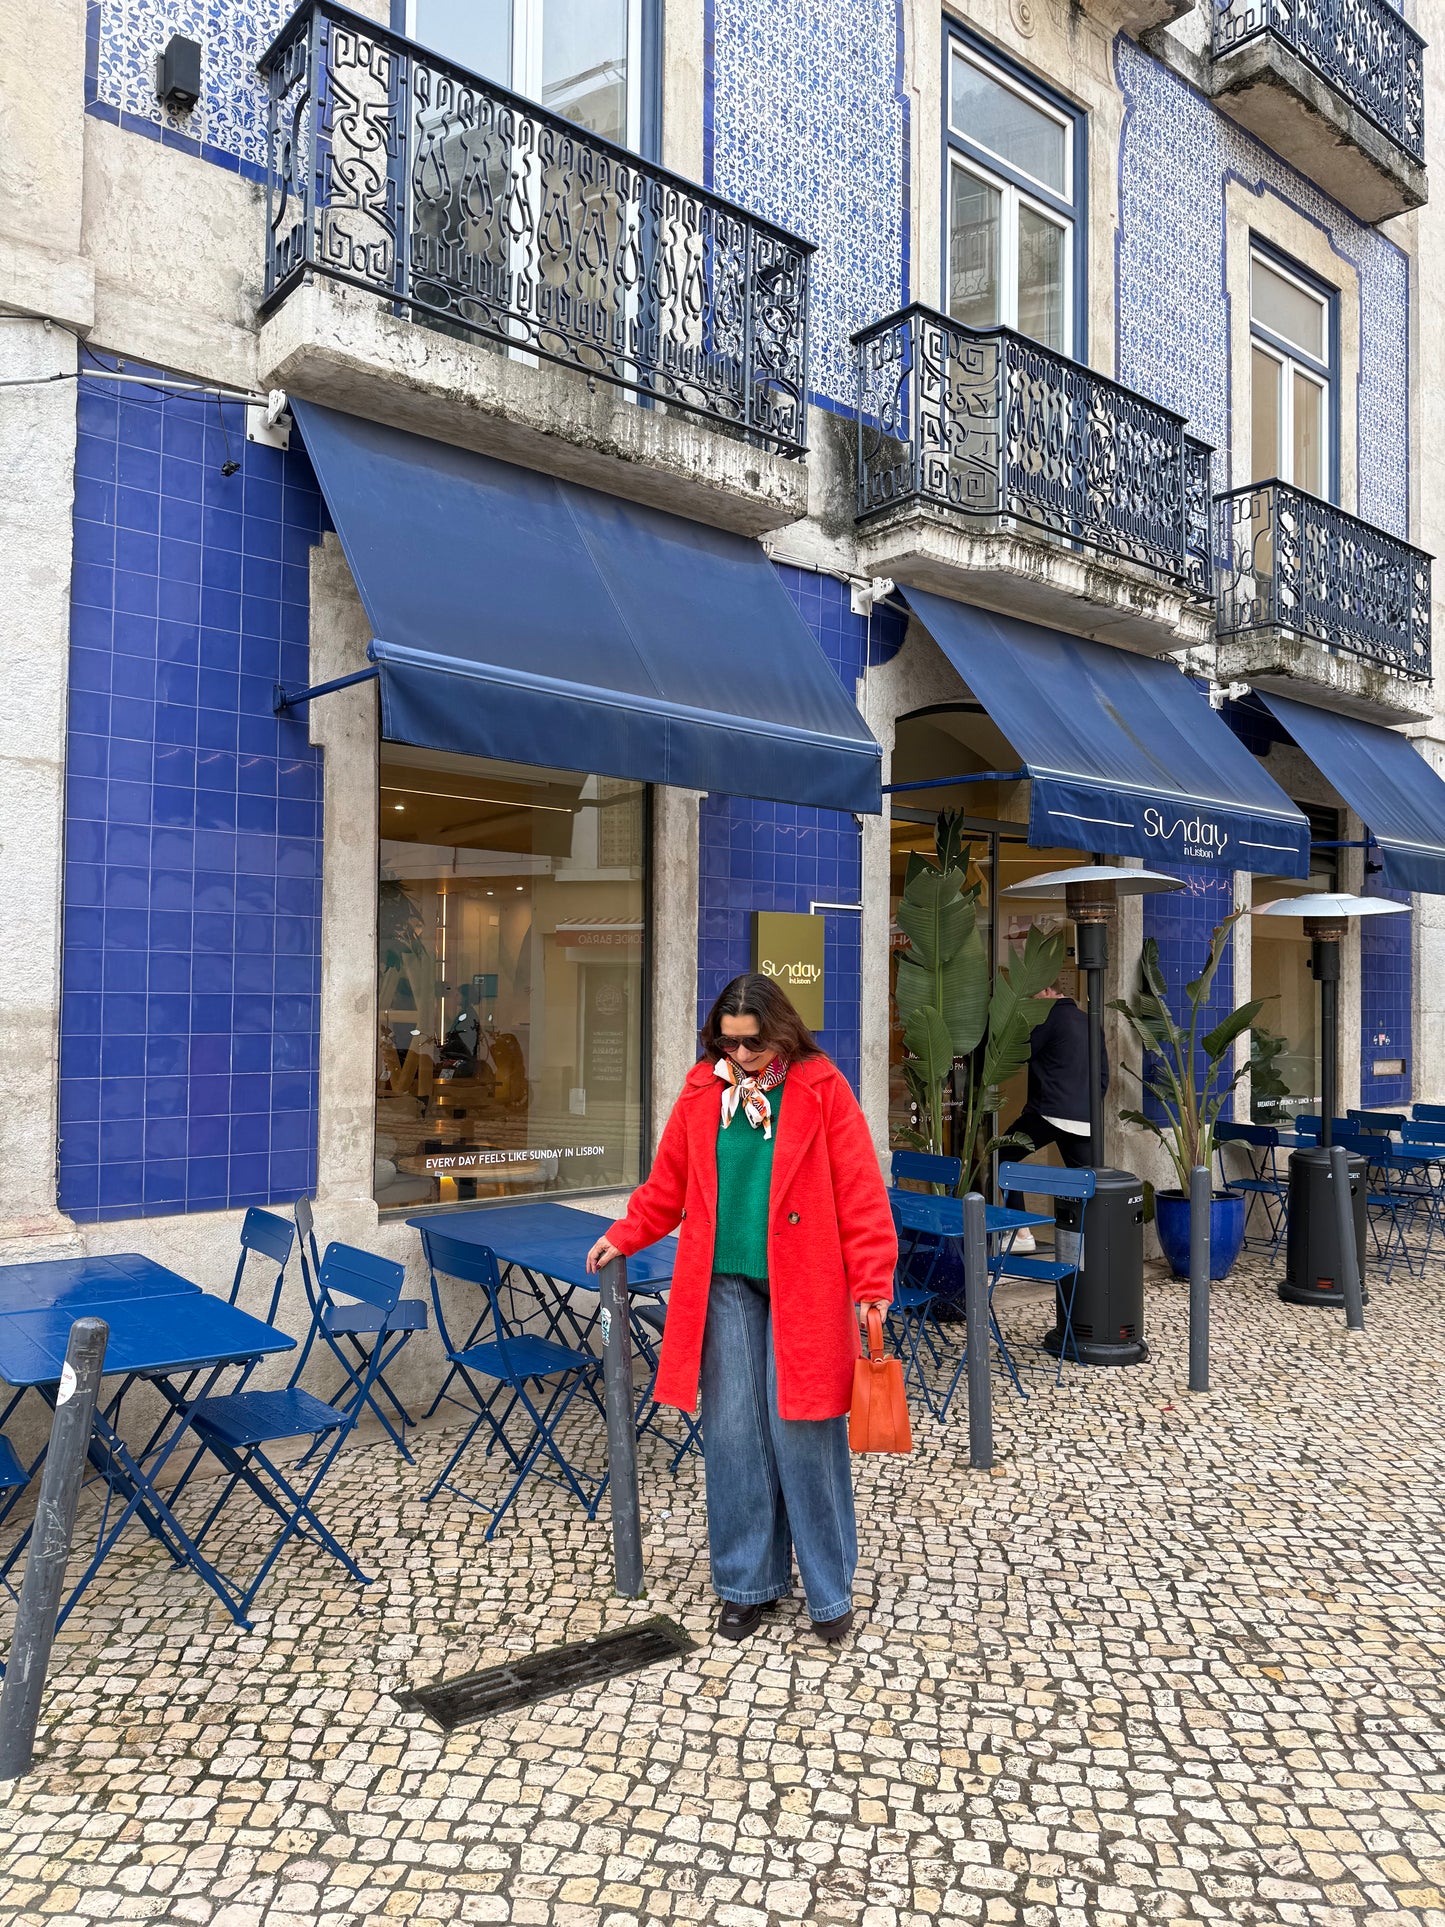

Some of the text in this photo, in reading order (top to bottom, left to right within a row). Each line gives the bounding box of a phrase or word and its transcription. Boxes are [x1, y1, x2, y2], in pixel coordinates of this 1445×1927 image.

[1143, 808, 1228, 856] Sunday
[1183, 844, 1214, 859] in Lisbon
[762, 959, 821, 982] Sunday
[425, 1145, 605, 1169] EVERY DAY FEELS LIKE SUNDAY IN LISBON
